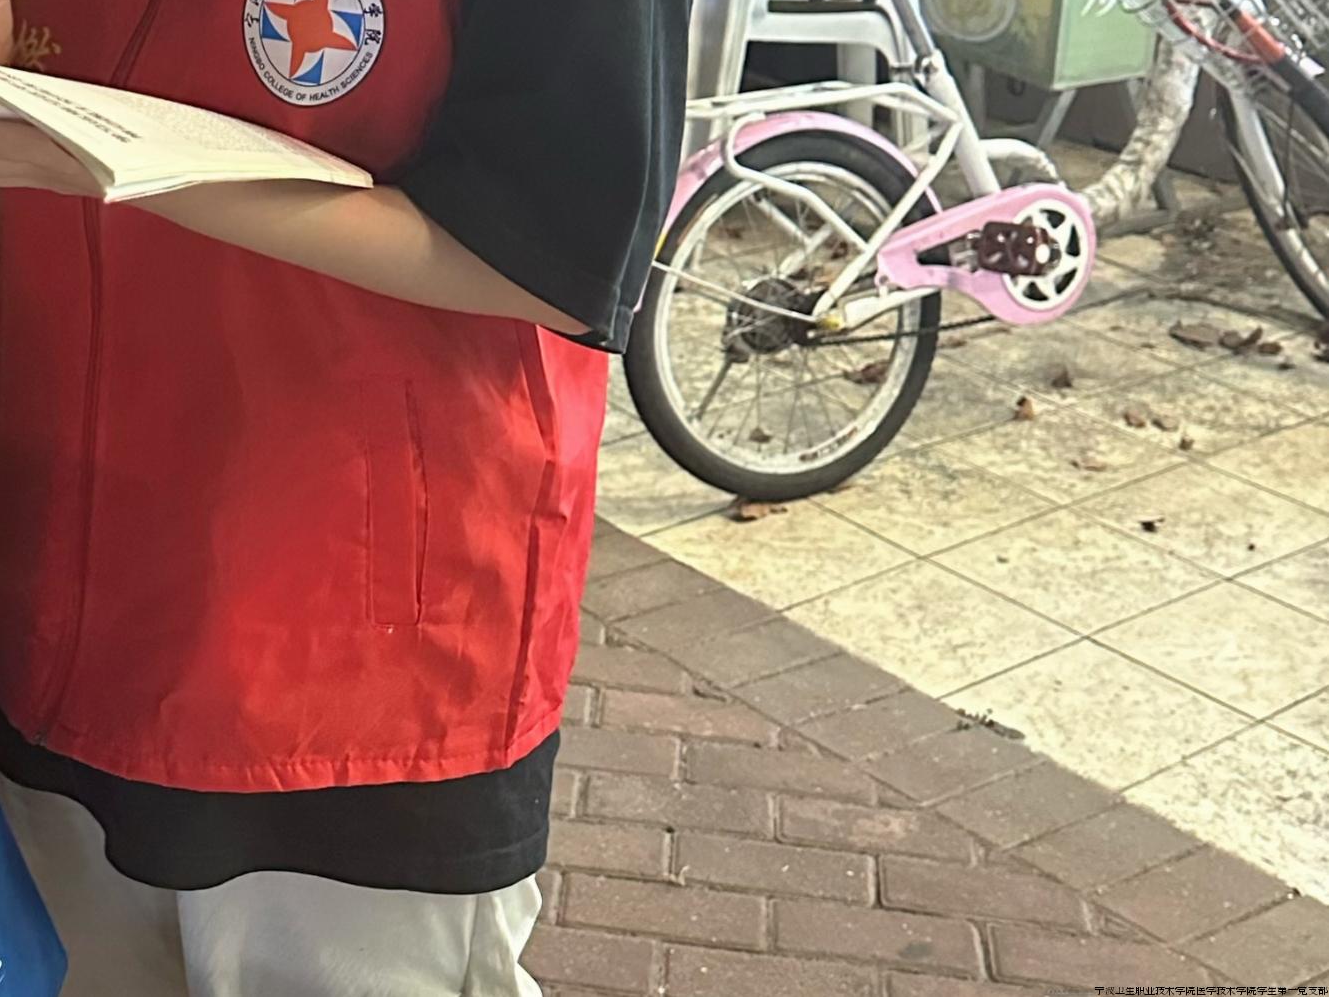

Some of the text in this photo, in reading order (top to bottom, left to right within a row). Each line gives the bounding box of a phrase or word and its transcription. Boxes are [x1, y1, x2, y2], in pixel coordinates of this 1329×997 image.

[248, 36, 373, 101] NINGBO COLLEGE OF HEALTH SCIENCES
